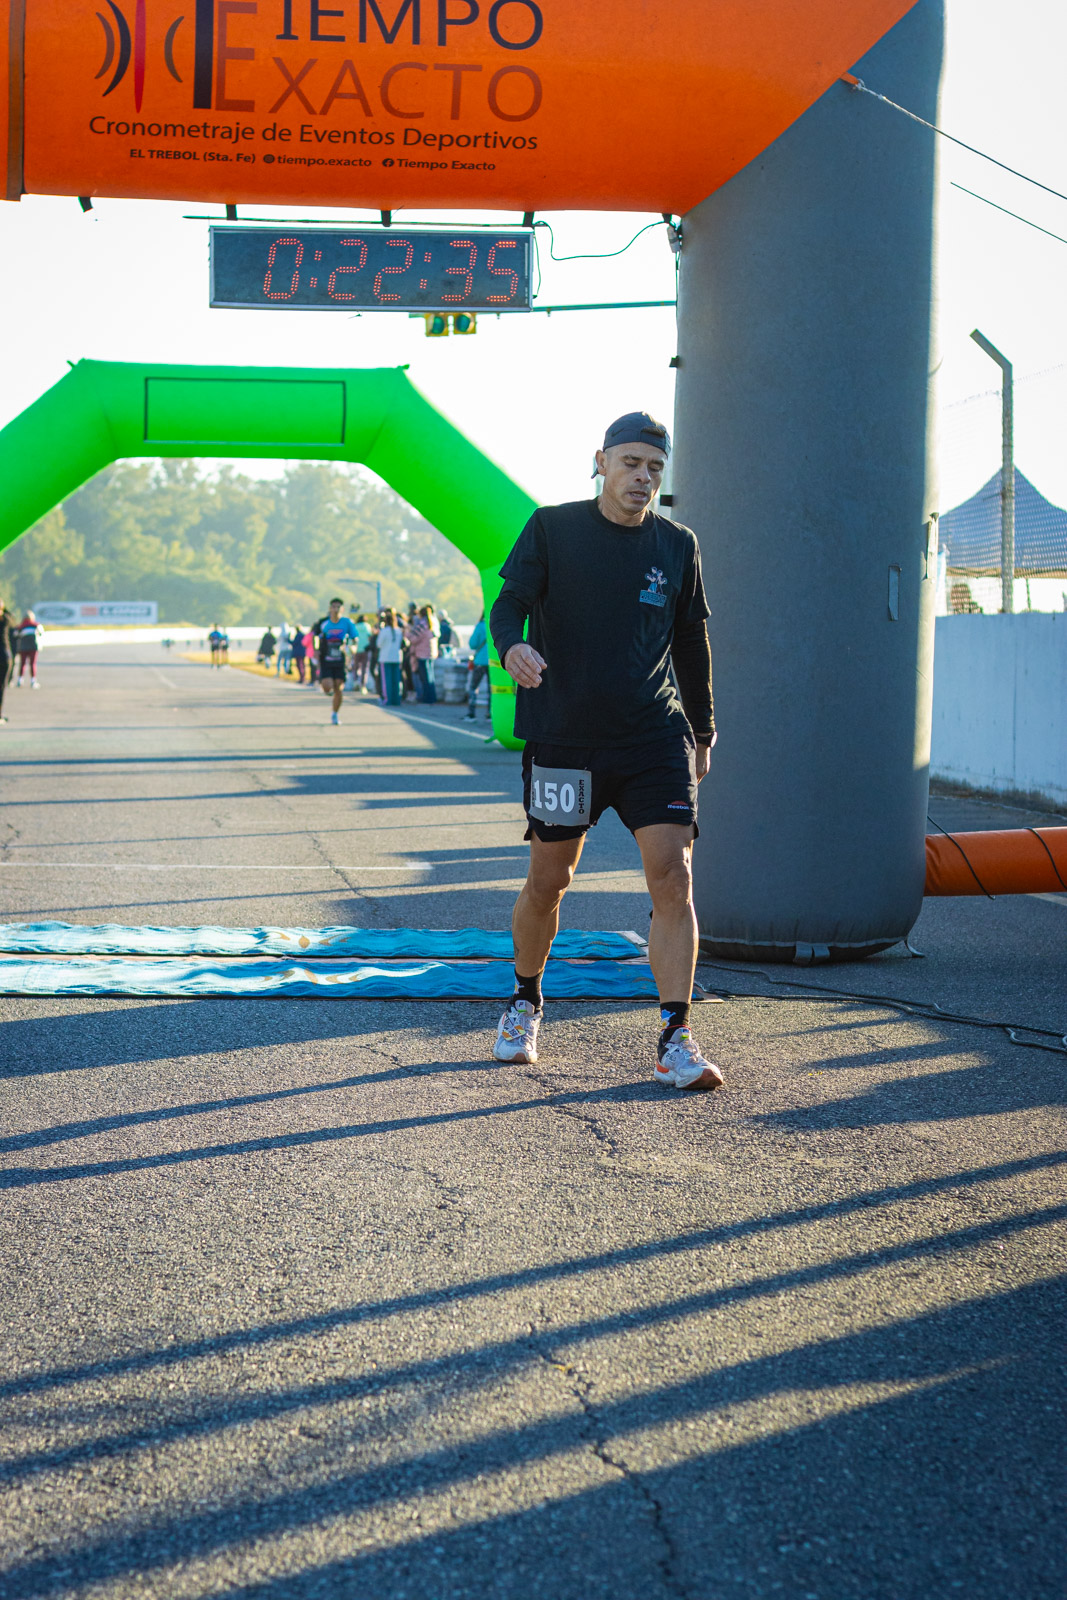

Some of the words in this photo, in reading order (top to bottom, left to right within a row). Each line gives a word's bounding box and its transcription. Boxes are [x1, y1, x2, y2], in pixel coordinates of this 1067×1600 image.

[89, 116, 255, 144] Cronometraje
[262, 122, 292, 141] de
[300, 124, 395, 145] Eventos
[403, 128, 538, 151] Deportivos
[130, 149, 145, 158] EL
[147, 150, 199, 161] TREBOL
[203, 152, 233, 162] (Sta.
[236, 153, 256, 163] Fe)
[277, 155, 372, 167] tiempo.exacto
[397, 158, 448, 170] Tiempo
[451, 160, 496, 171] Exacto
[263, 238, 518, 302] 0:22:35
[534, 780, 575, 812] 150
